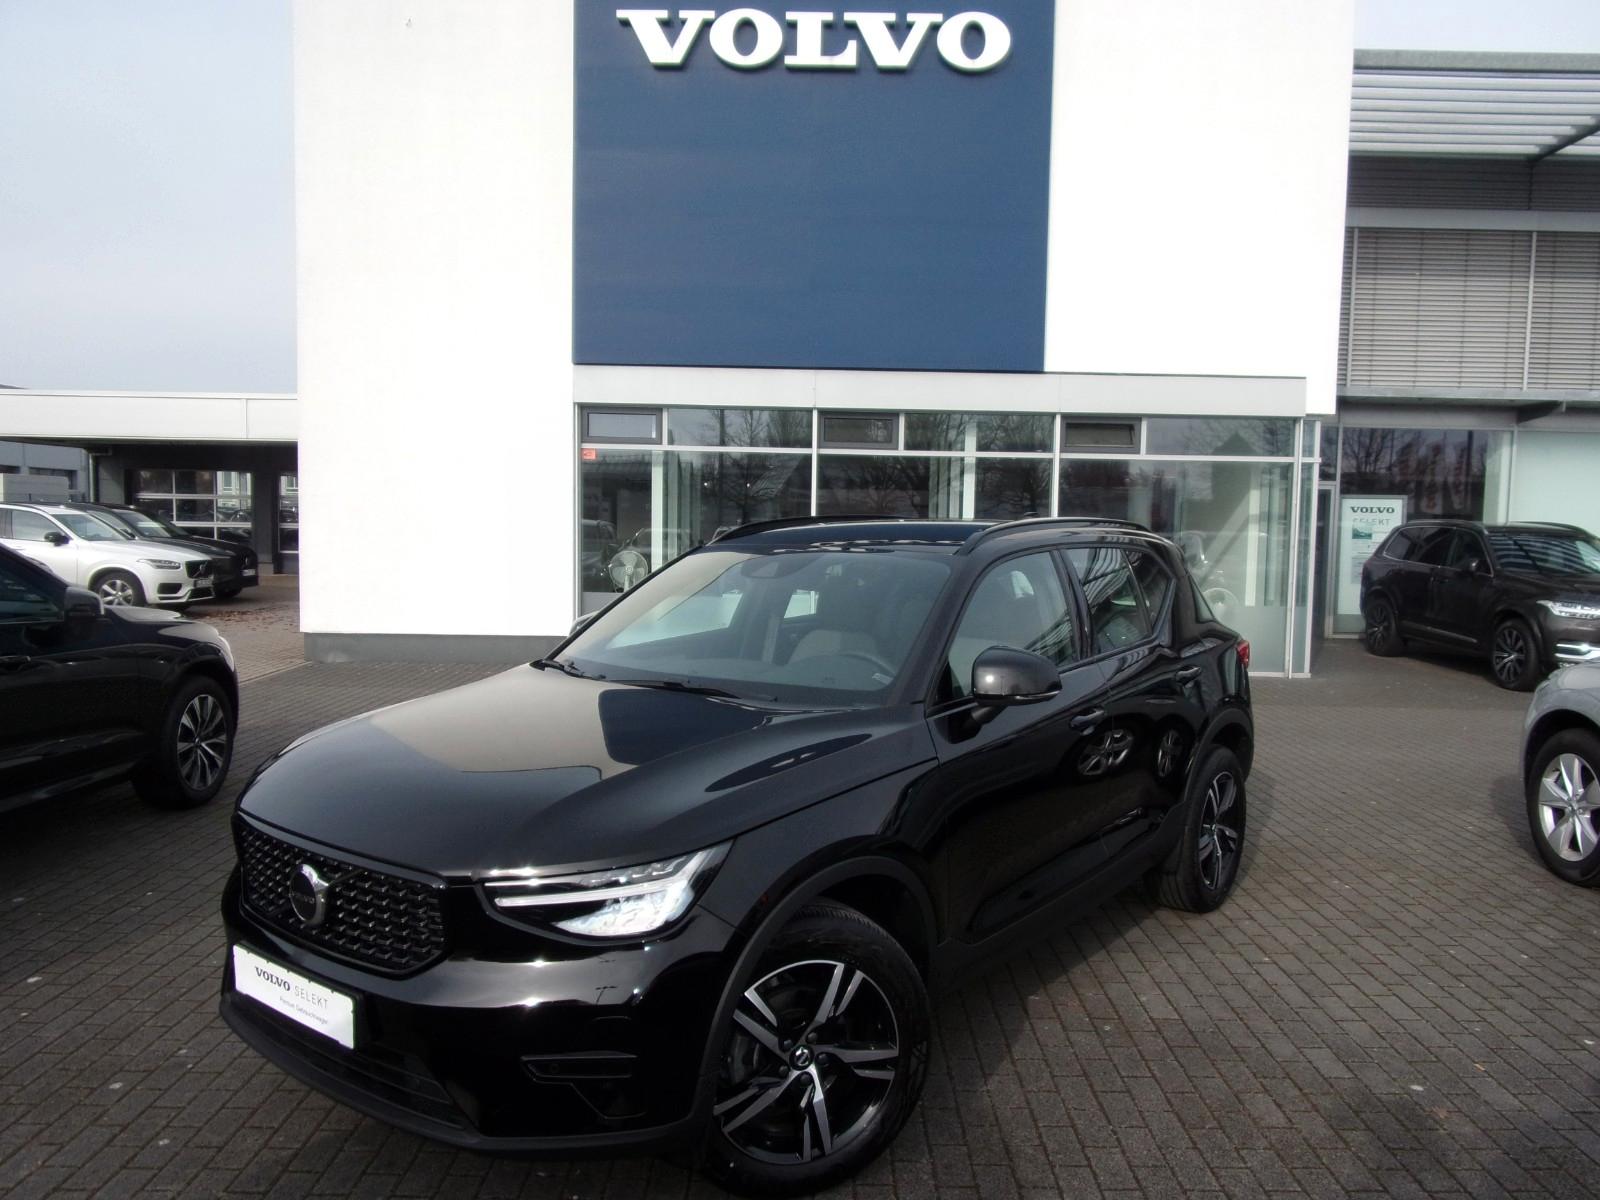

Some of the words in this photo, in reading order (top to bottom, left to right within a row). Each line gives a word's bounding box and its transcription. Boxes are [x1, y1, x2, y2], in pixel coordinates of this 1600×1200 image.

[615, 7, 1012, 71] VOLVO
[255, 966, 291, 991] VOLVO
[294, 985, 328, 1009] SELEKT
